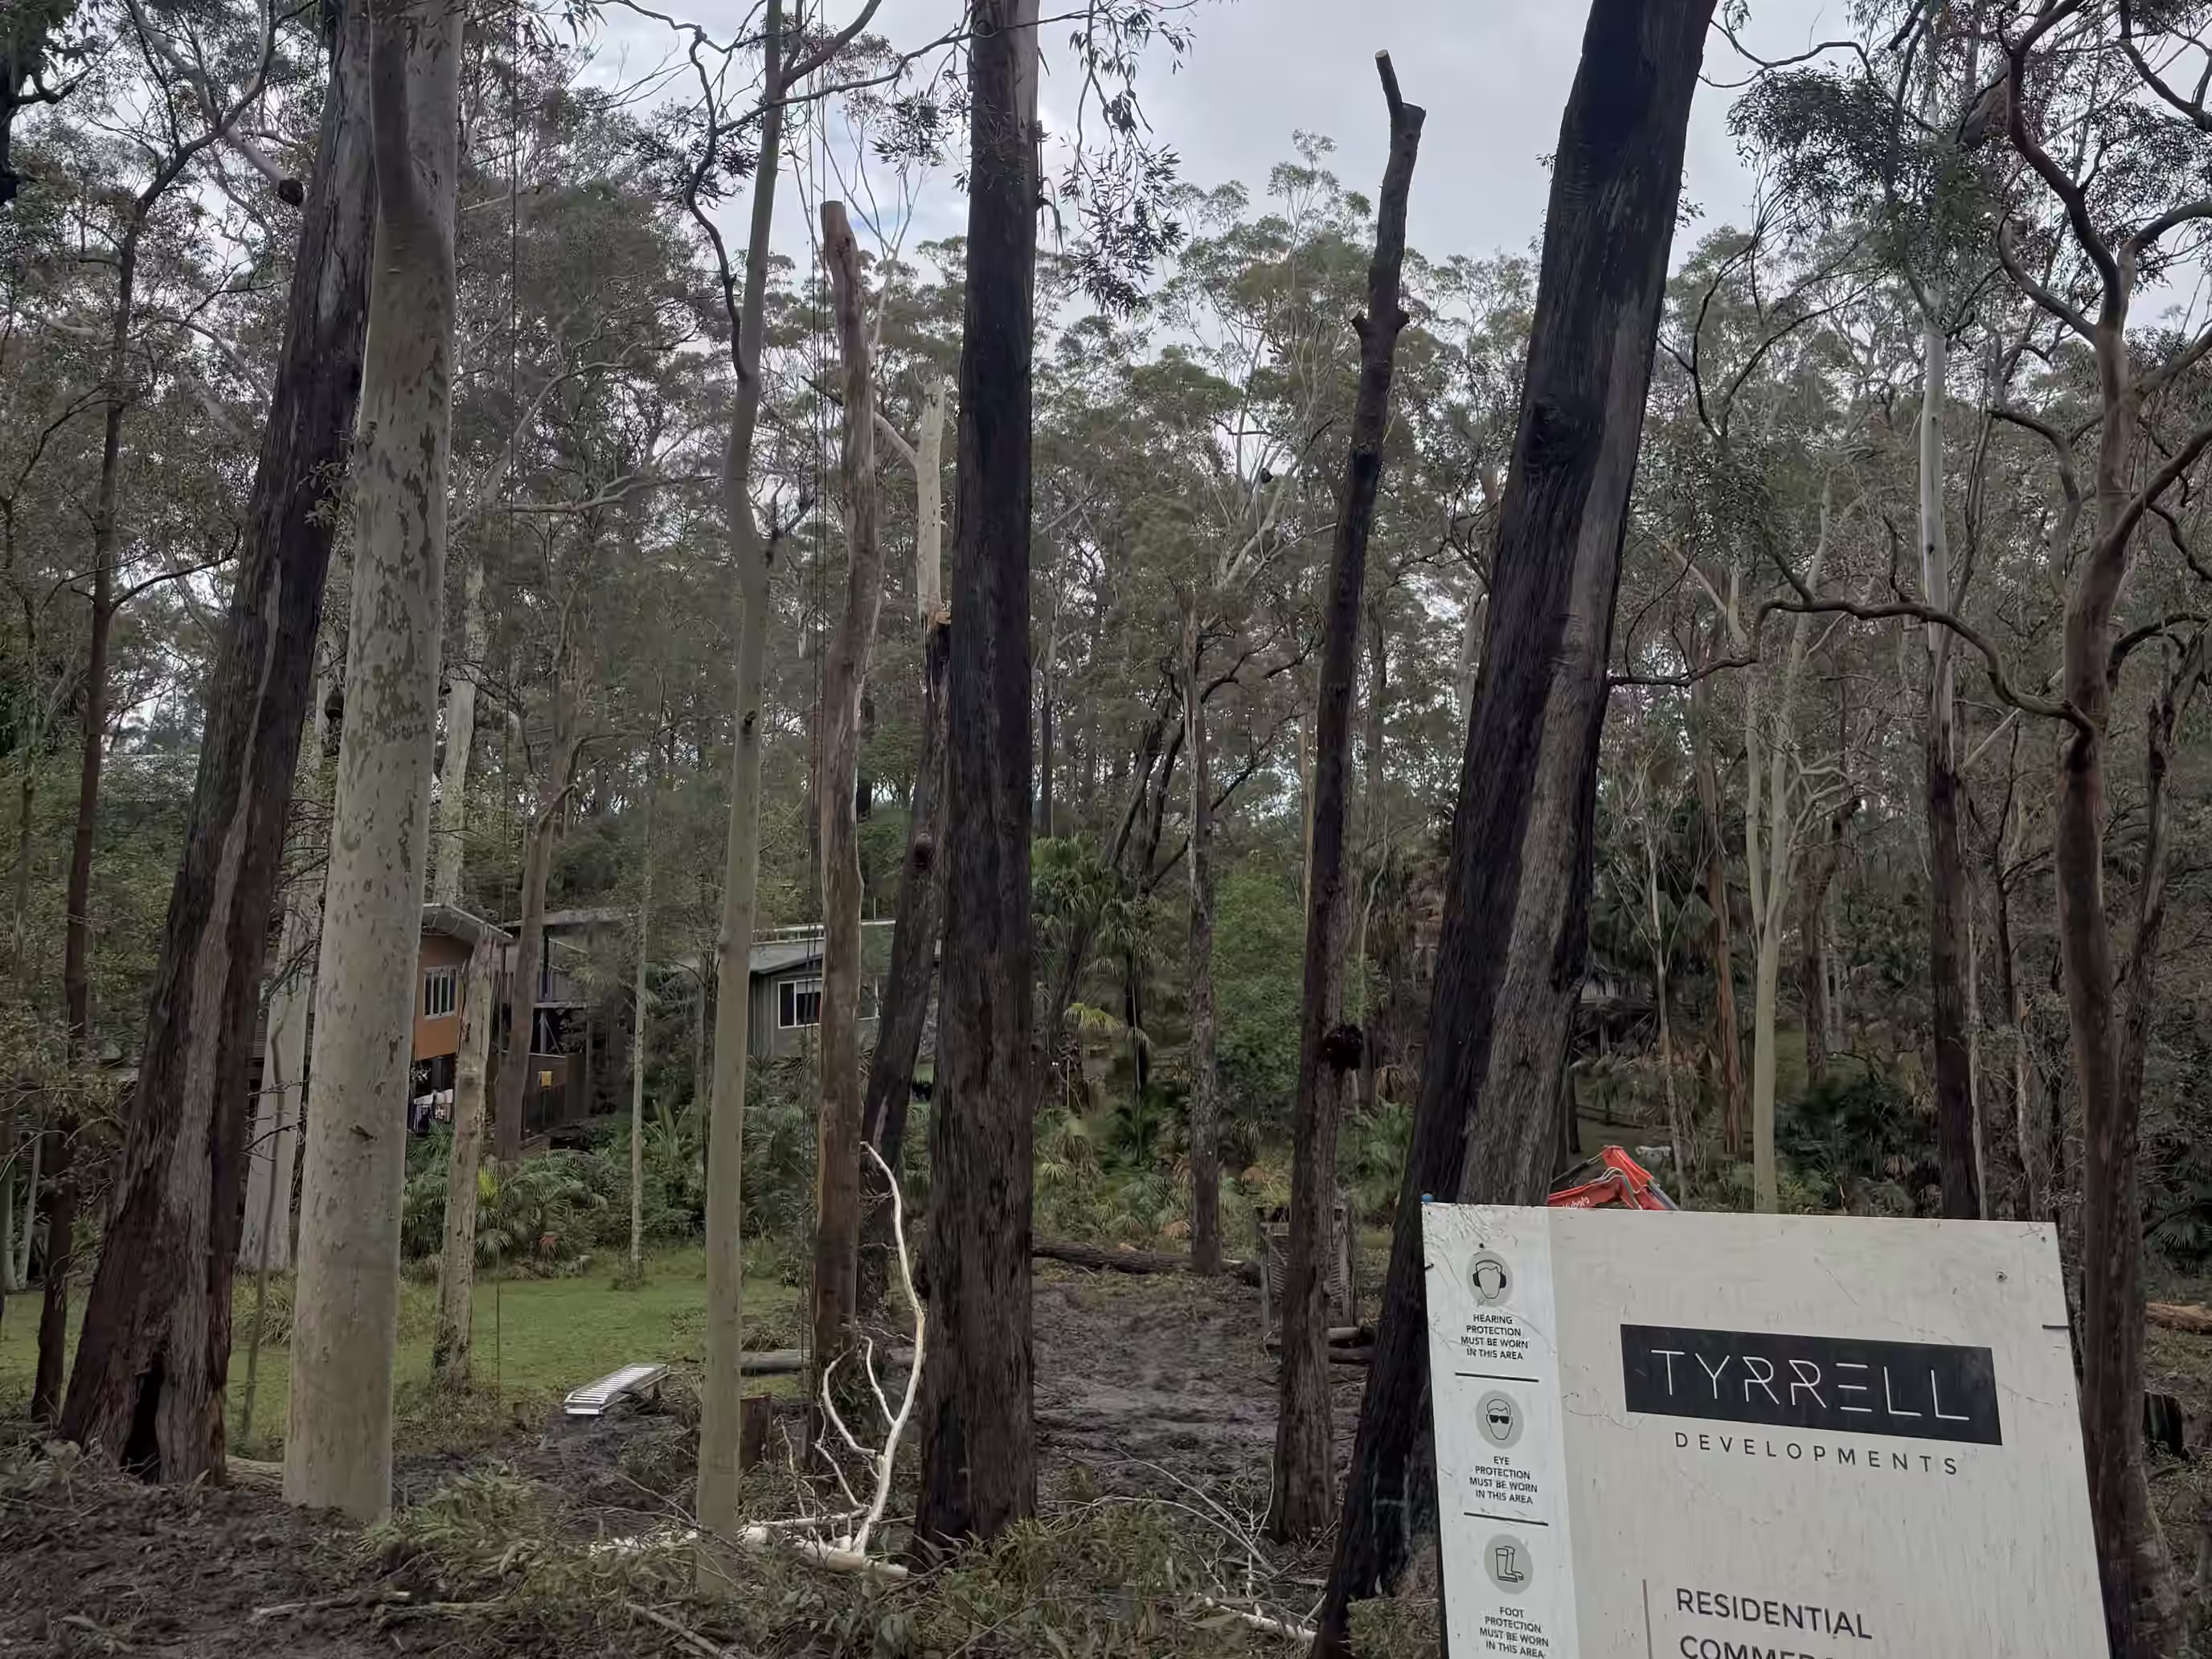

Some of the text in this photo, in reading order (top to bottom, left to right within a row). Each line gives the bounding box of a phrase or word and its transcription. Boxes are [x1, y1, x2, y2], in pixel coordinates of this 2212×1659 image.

[1473, 1314, 1513, 1324] HEARING
[1466, 1325, 1522, 1337] PROTECTION
[1461, 1336, 1528, 1349] MUST BE WORN
[1467, 1348, 1524, 1360] IN THIS AREA
[1651, 1350, 1969, 1420] TYRRELL
[1493, 1456, 1509, 1465] EYE
[1675, 1432, 1957, 1475] DEVELOPMENTS
[1475, 1465, 1530, 1480] PROTECTION
[1469, 1477, 1538, 1493] MUST BE WORN
[1476, 1489, 1533, 1505] IN THIS AREA
[1500, 1607, 1524, 1618] FOOT
[1676, 1587, 1873, 1640] RESIDENTIAL
[1485, 1616, 1542, 1633] PROTECTION
[1480, 1627, 1549, 1647] MUST BE WORN
[1486, 1641, 1544, 1658] IN THIS AREA
